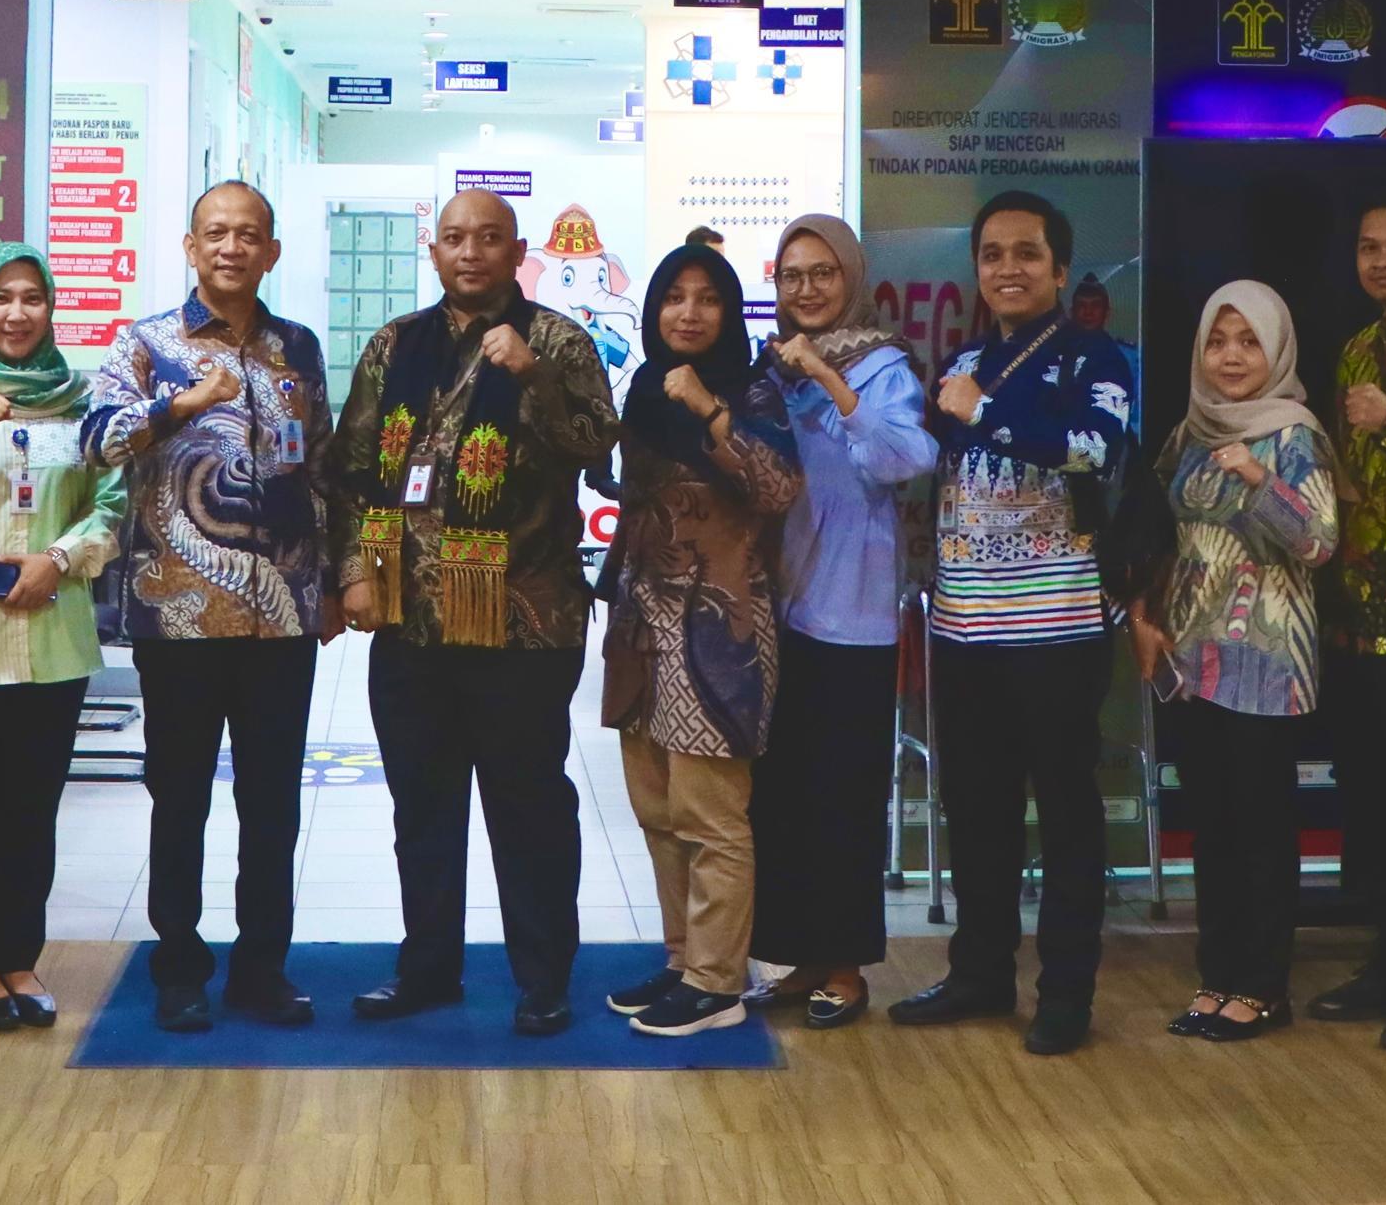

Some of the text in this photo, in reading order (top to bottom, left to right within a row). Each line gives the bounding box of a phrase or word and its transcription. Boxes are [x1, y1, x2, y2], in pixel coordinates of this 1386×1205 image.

[793, 14, 818, 26] LOKET
[760, 29, 844, 41] PENGAMBILAN PASPO
[1025, 34, 1069, 45] IMIGRASI
[1312, 51, 1355, 61] IMIGRASI
[457, 63, 486, 75] SEKSI
[53, 119, 81, 129] OHONAN
[83, 120, 110, 129] PASPOR
[892, 111, 1121, 130] DIREKTORAT JENDERAL IMIGRASI
[56, 131, 140, 140] HABIS BERLAKU PENUH
[949, 135, 1065, 152] SIAP MENCEGAH
[869, 158, 919, 174] TINDAK
[924, 158, 977, 175] PIDANA
[981, 158, 1090, 176] PERDAGANGAN
[457, 174, 531, 184] RUANG PENGADUAN
[117, 185, 136, 207] 2.
[116, 255, 135, 276] 4.
